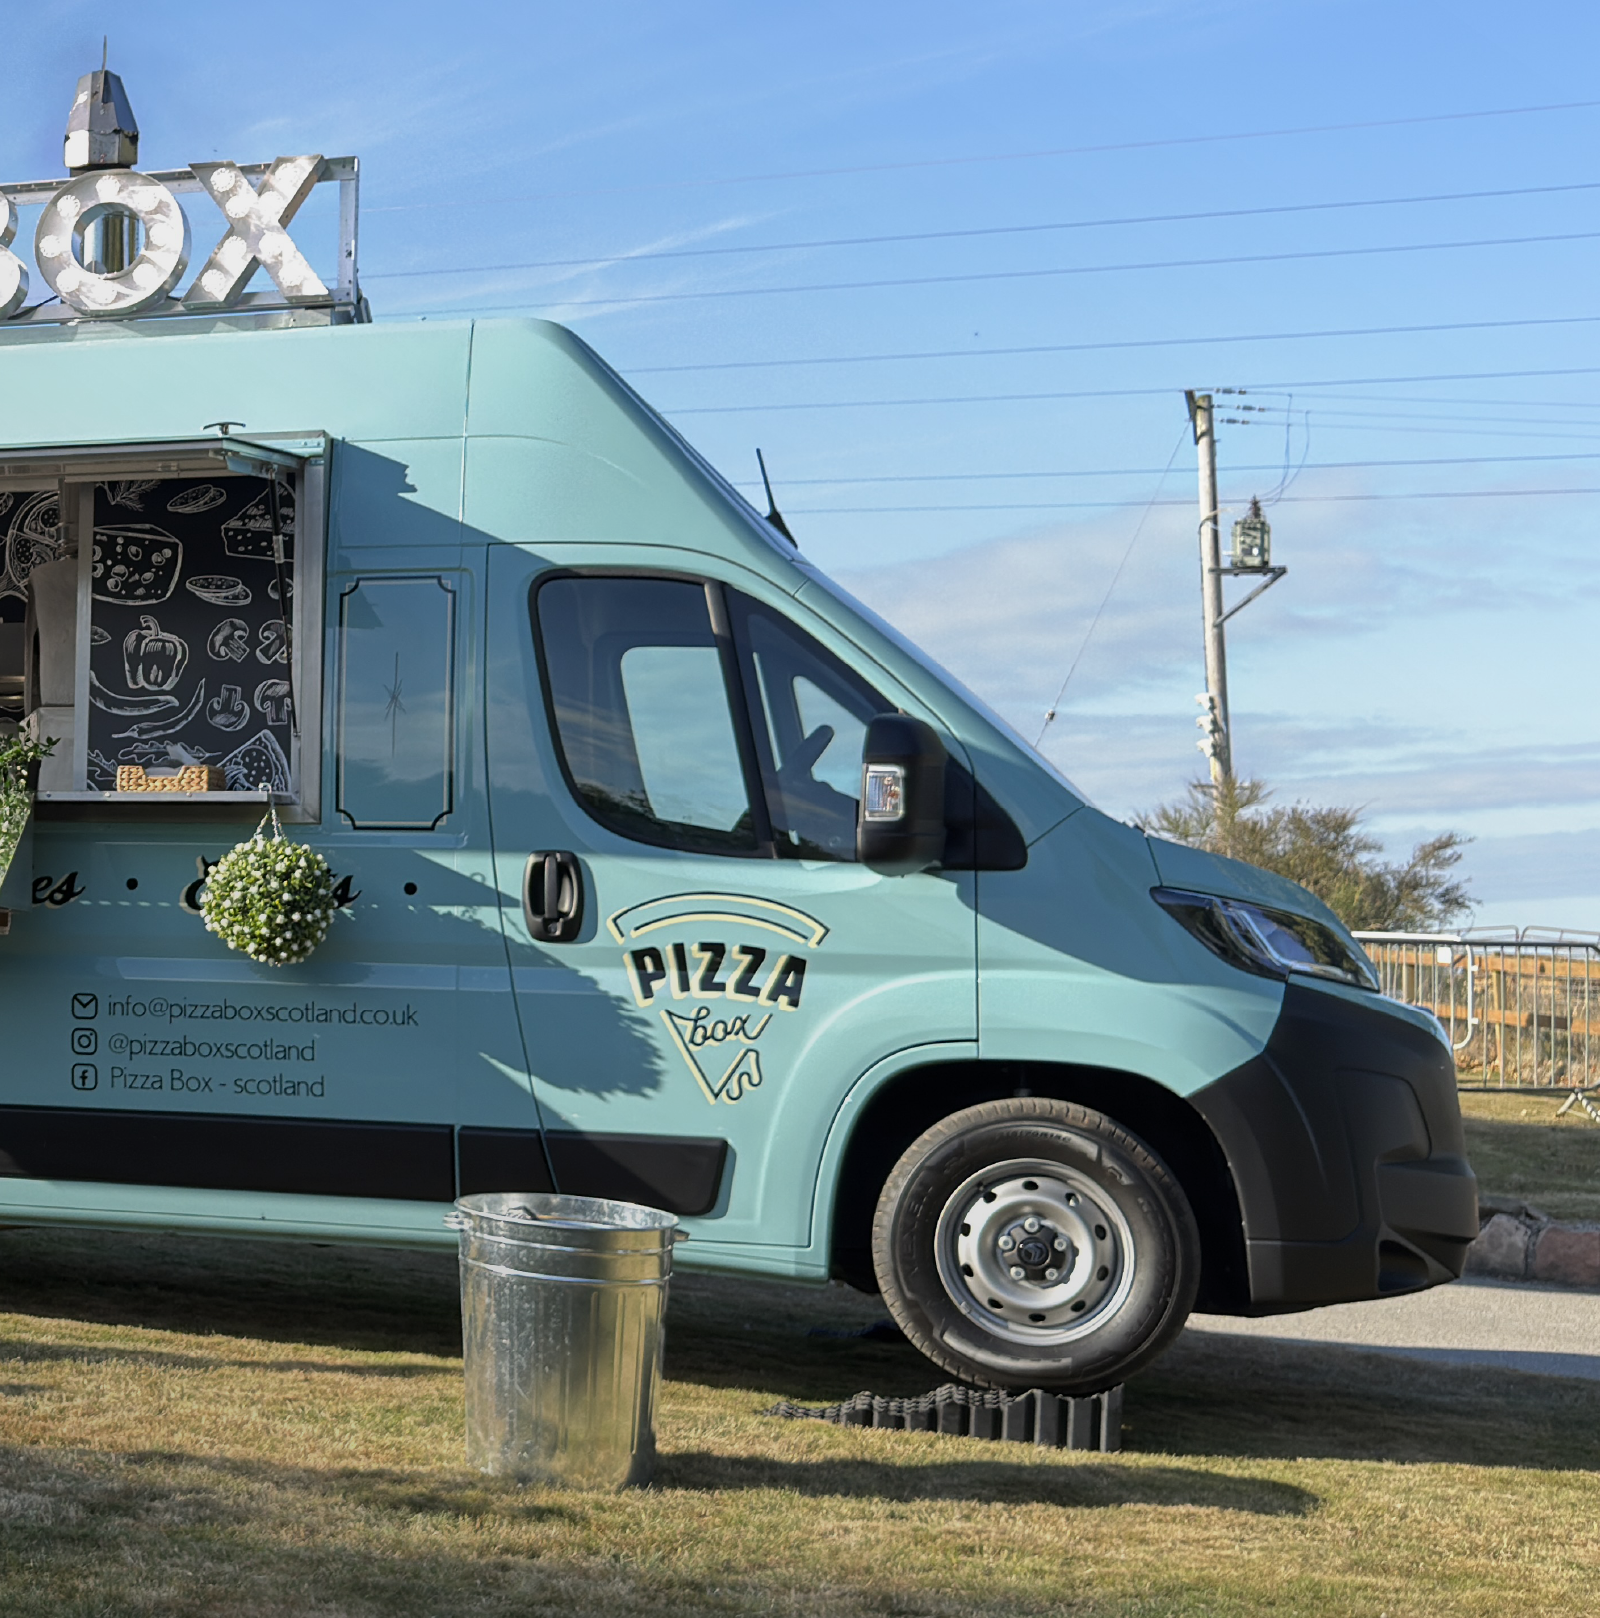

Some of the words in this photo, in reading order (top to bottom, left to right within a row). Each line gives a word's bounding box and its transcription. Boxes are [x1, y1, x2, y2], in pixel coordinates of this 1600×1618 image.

[623, 942, 808, 1011] PIZZA
[108, 994, 419, 1027] info@pizzaboxscotland.co.uk
[682, 1006, 773, 1049] box
[108, 1033, 315, 1062] @pizzaboxscotland
[111, 1066, 163, 1091] Pizza
[170, 1068, 213, 1093] Box
[234, 1073, 325, 1098] scotland
